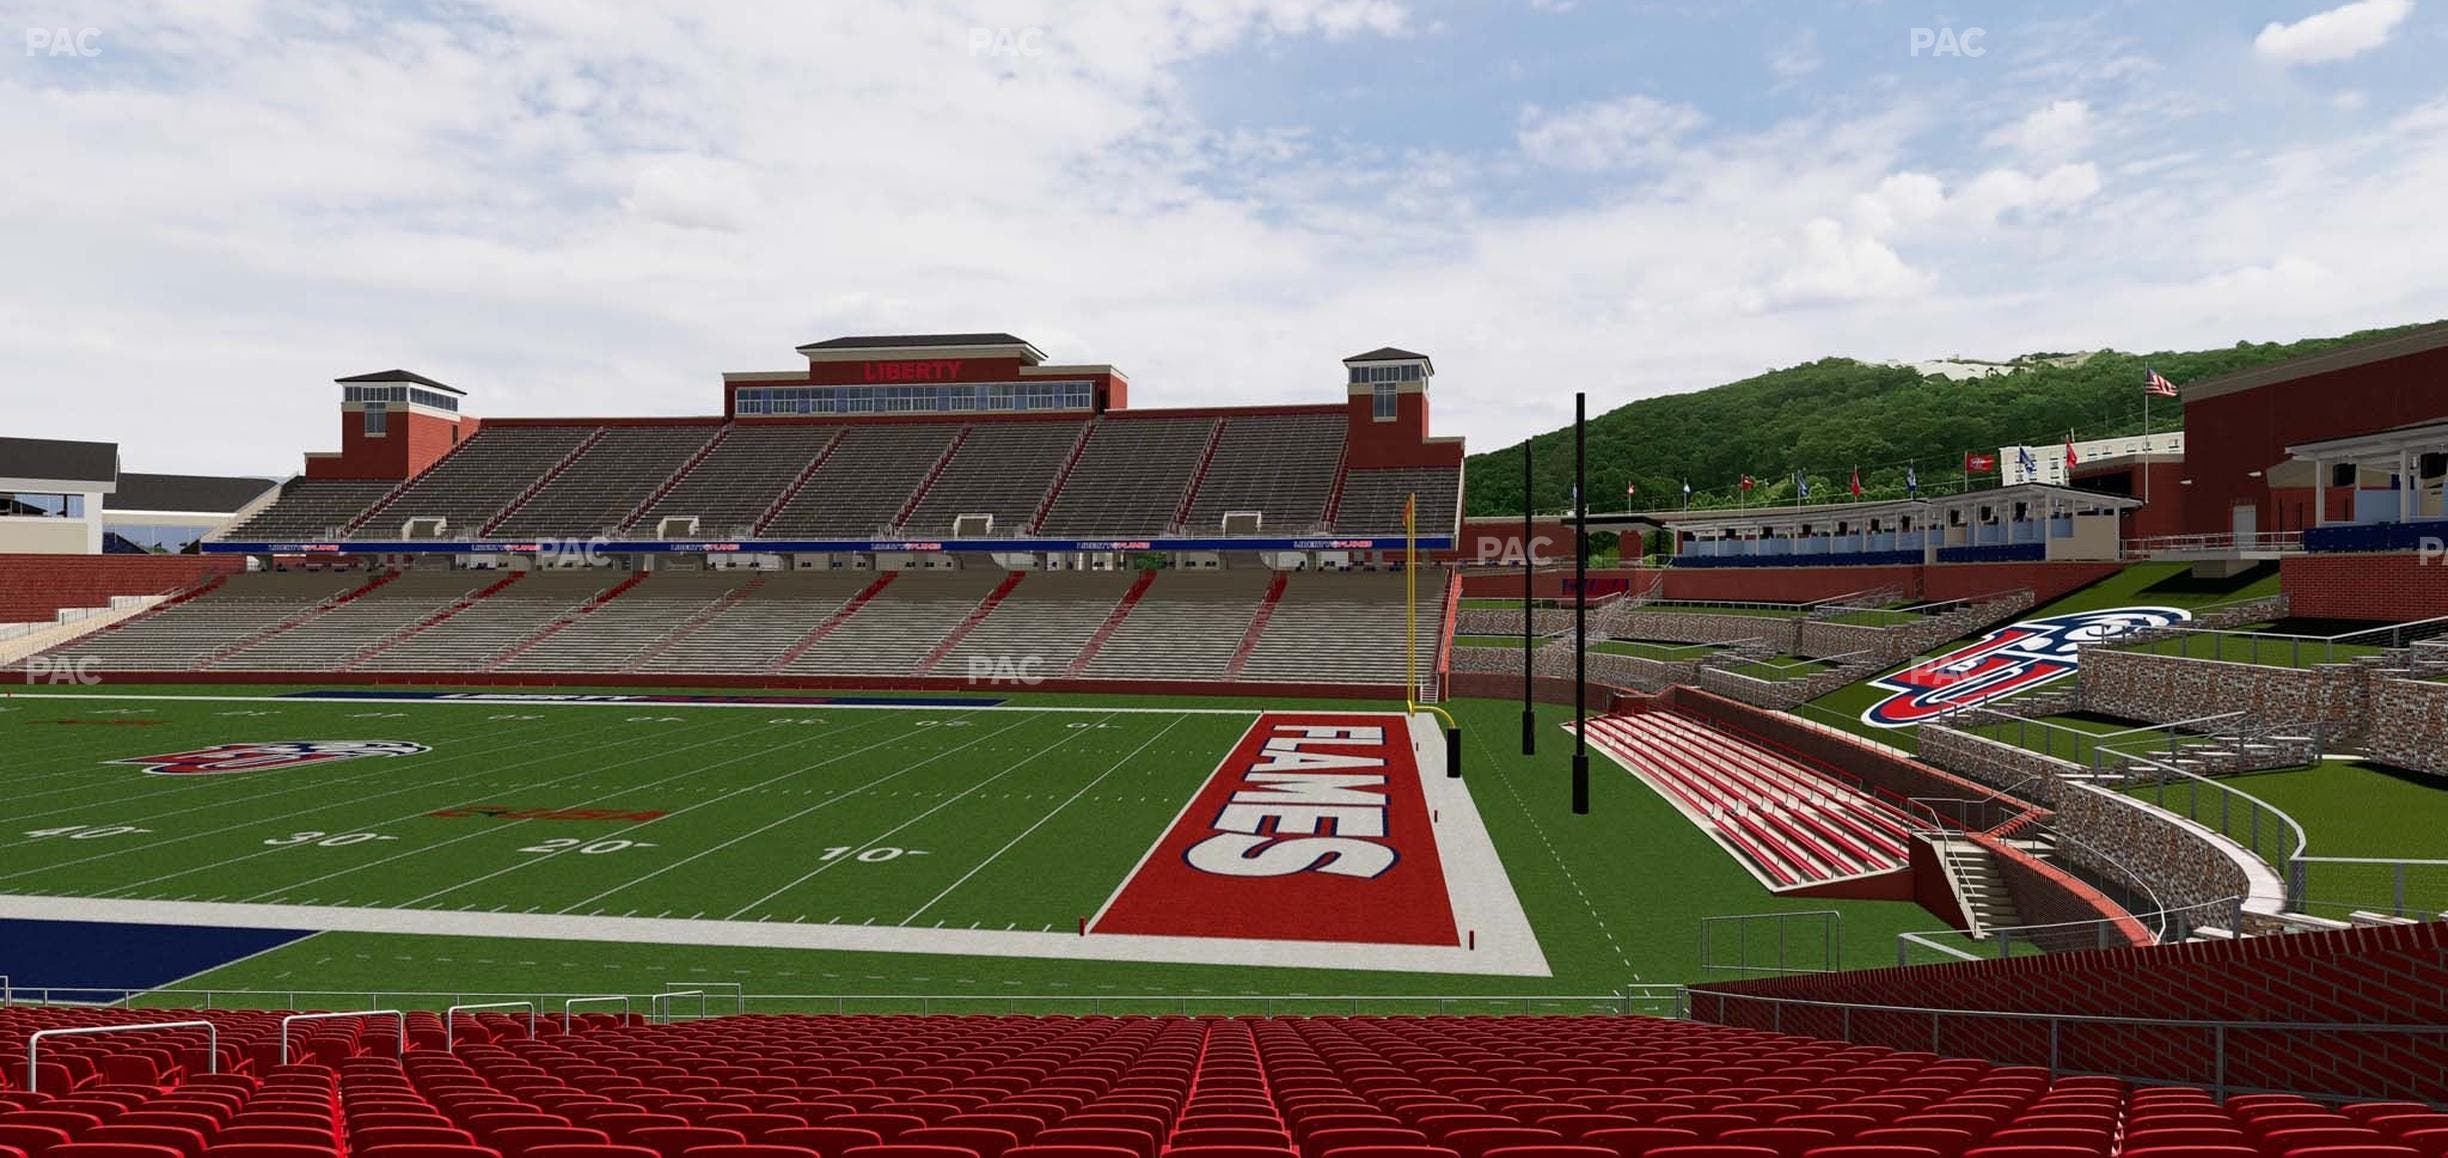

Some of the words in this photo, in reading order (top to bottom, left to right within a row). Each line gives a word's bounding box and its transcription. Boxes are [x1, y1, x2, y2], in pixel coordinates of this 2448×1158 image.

[863, 361, 963, 382] LIBERTY
[1181, 725, 1401, 879] FLAMES
[264, 831, 378, 846] 30
[516, 838, 633, 854] 20
[819, 846, 904, 862] 10
